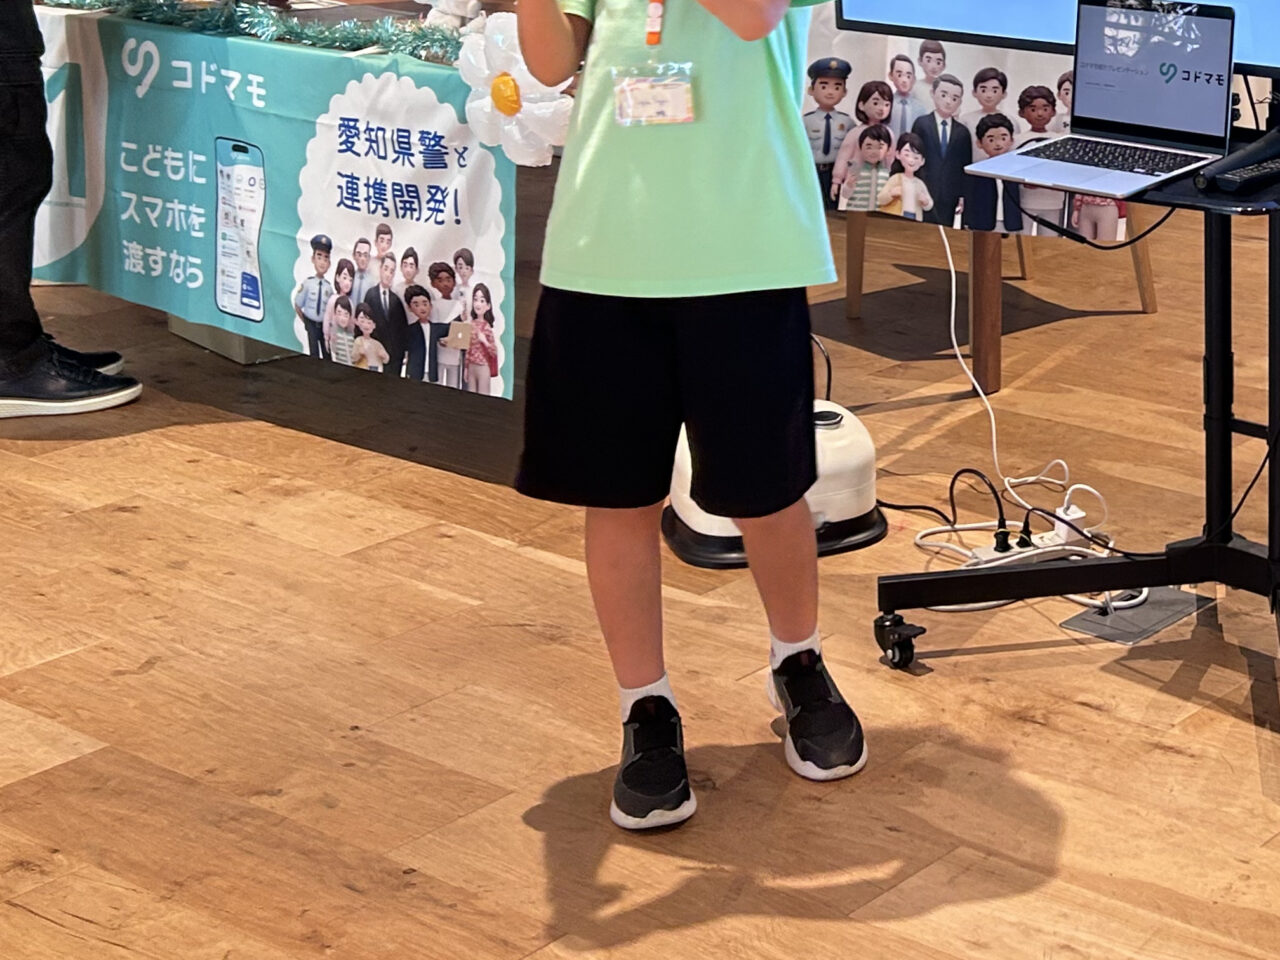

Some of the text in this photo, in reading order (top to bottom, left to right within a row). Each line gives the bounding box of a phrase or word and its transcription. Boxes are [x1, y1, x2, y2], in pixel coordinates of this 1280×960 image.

[171, 60, 267, 108] コドマモ
[1181, 70, 1225, 87] コドマモ
[120, 141, 208, 185] こどもに
[337, 116, 469, 170] 愛知県警と
[120, 191, 207, 239] スマホを
[122, 239, 205, 290] 渡すなら
